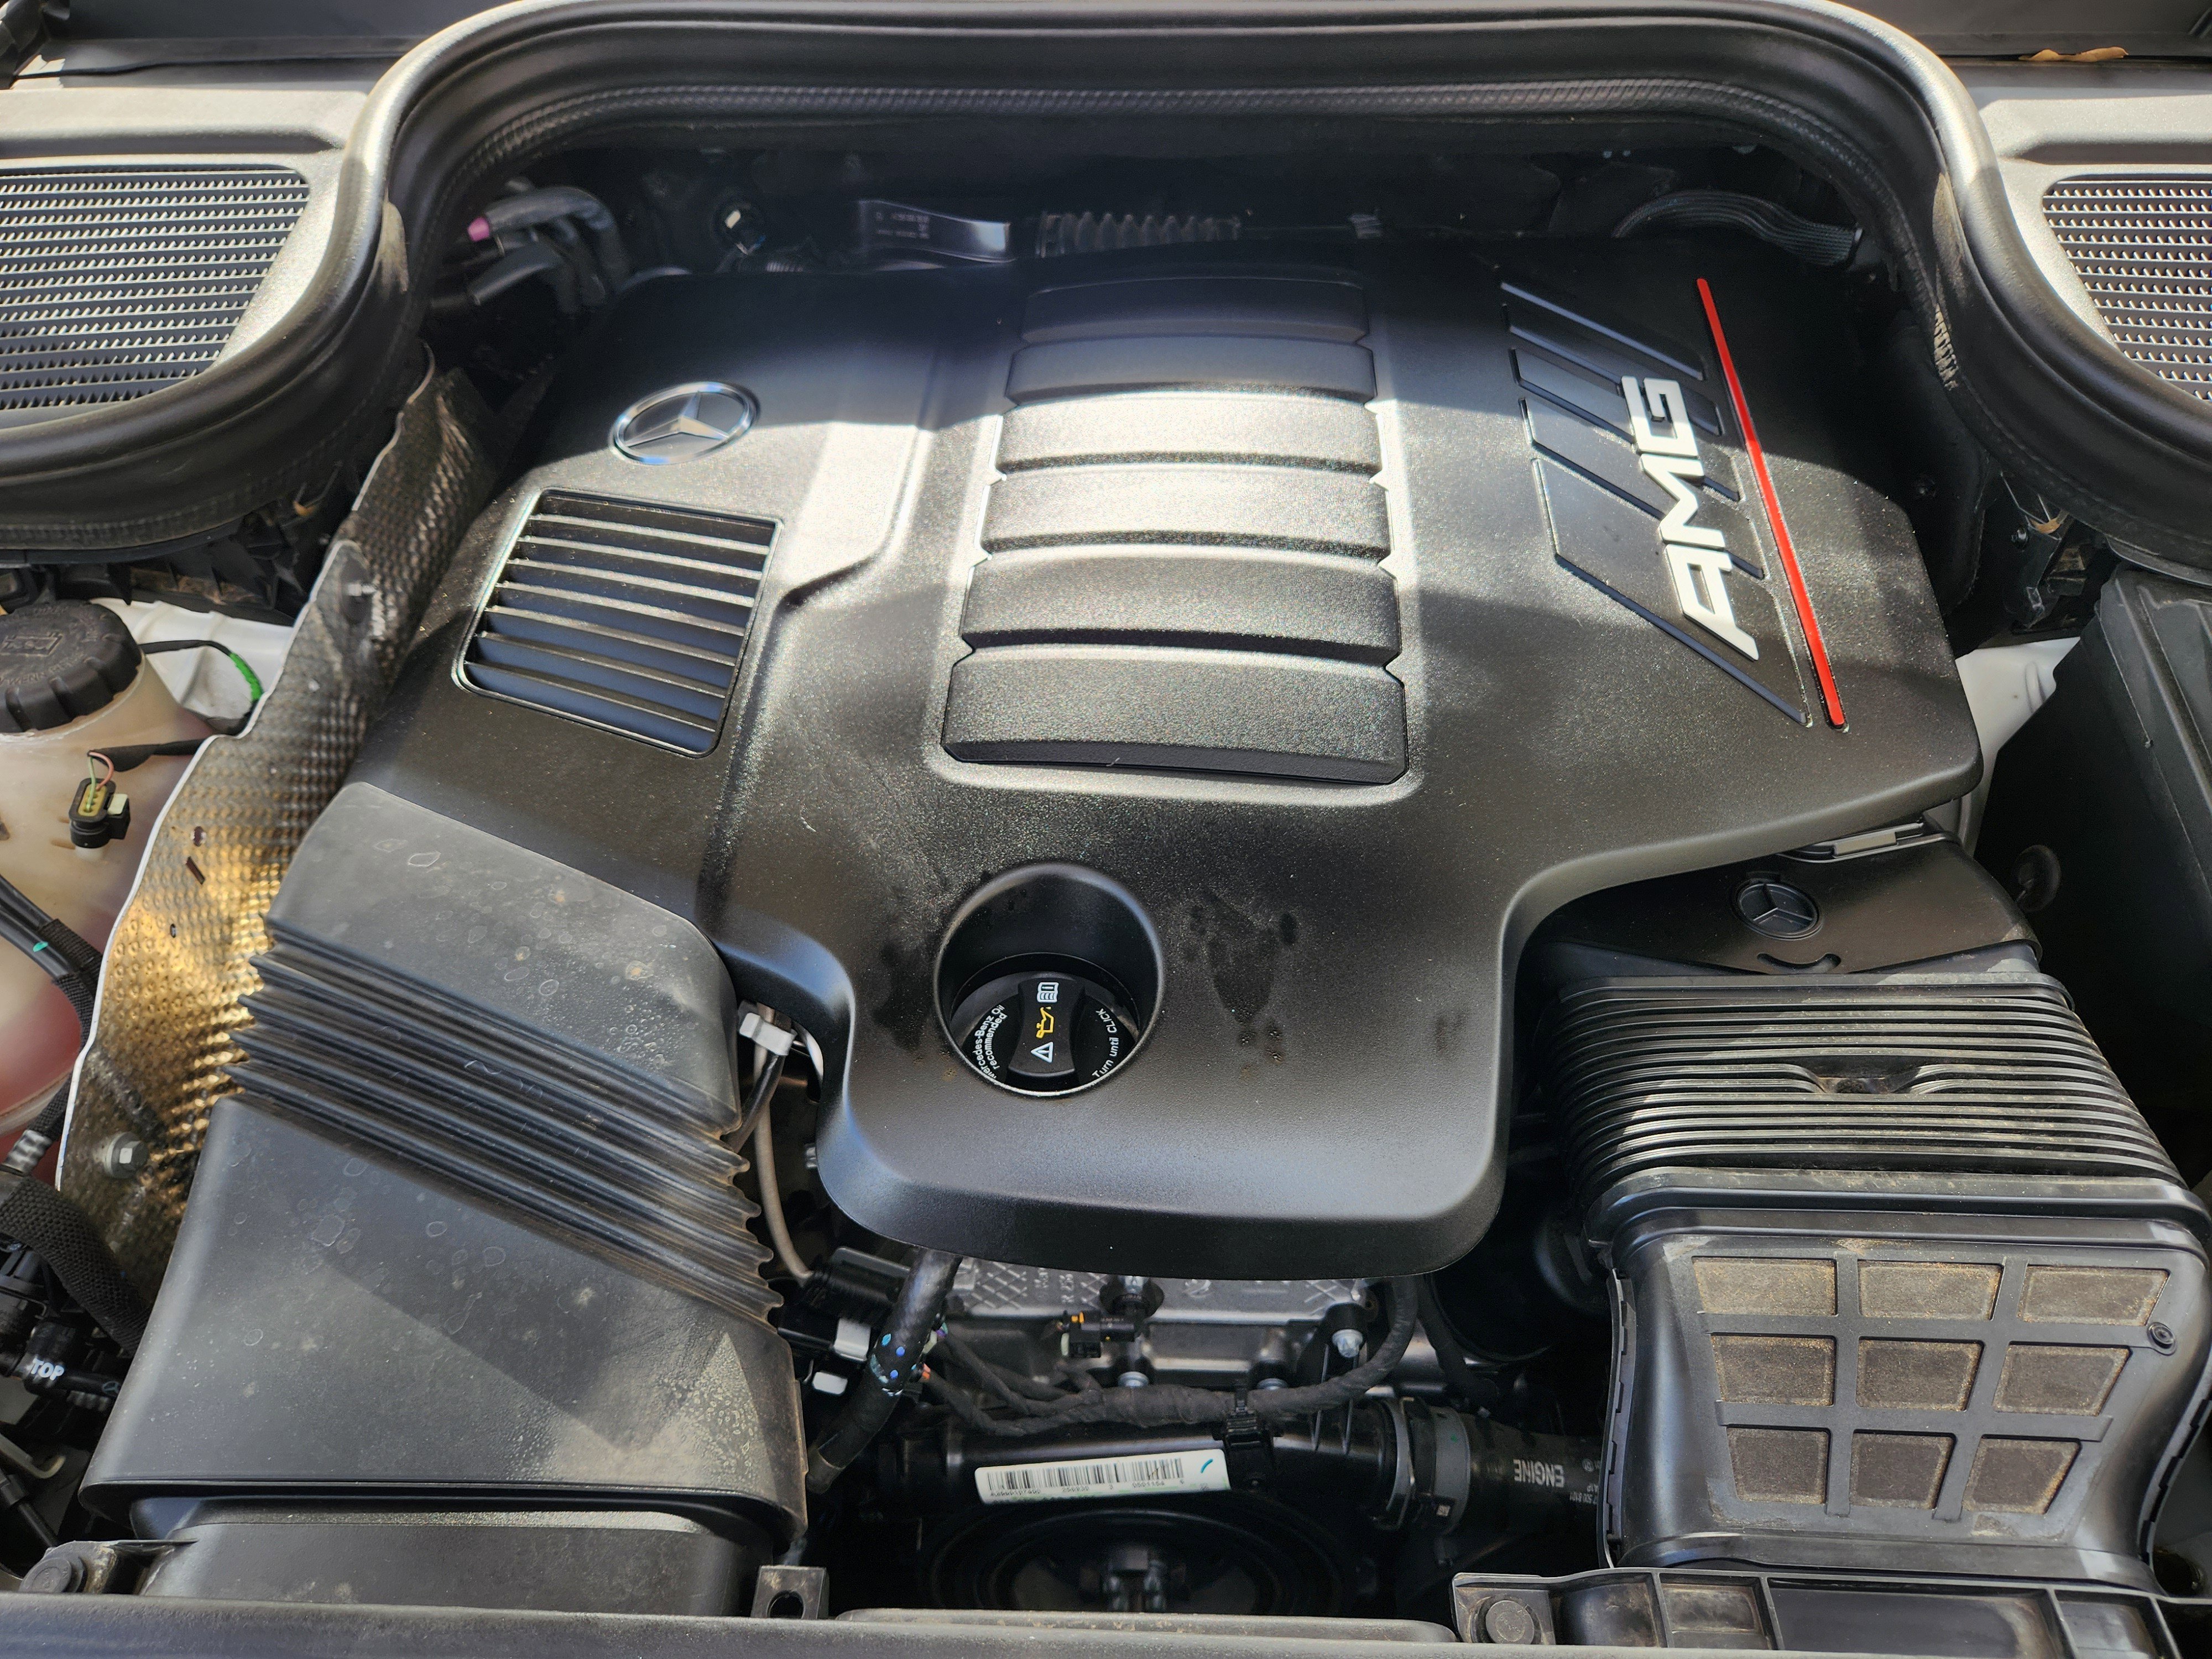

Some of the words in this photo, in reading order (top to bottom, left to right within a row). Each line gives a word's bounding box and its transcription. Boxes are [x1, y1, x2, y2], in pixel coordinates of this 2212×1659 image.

[1621, 375, 1759, 661] AMG
[992, 1004, 1005, 1015] Oil
[1095, 1008, 1117, 1033] CLICK
[984, 1012, 1008, 1070] recommended
[1109, 1037, 1119, 1057] until
[1092, 1060, 1114, 1077] Turn
[31, 1358, 64, 1380] TOP
[1513, 1458, 1565, 1488] ENGINE
